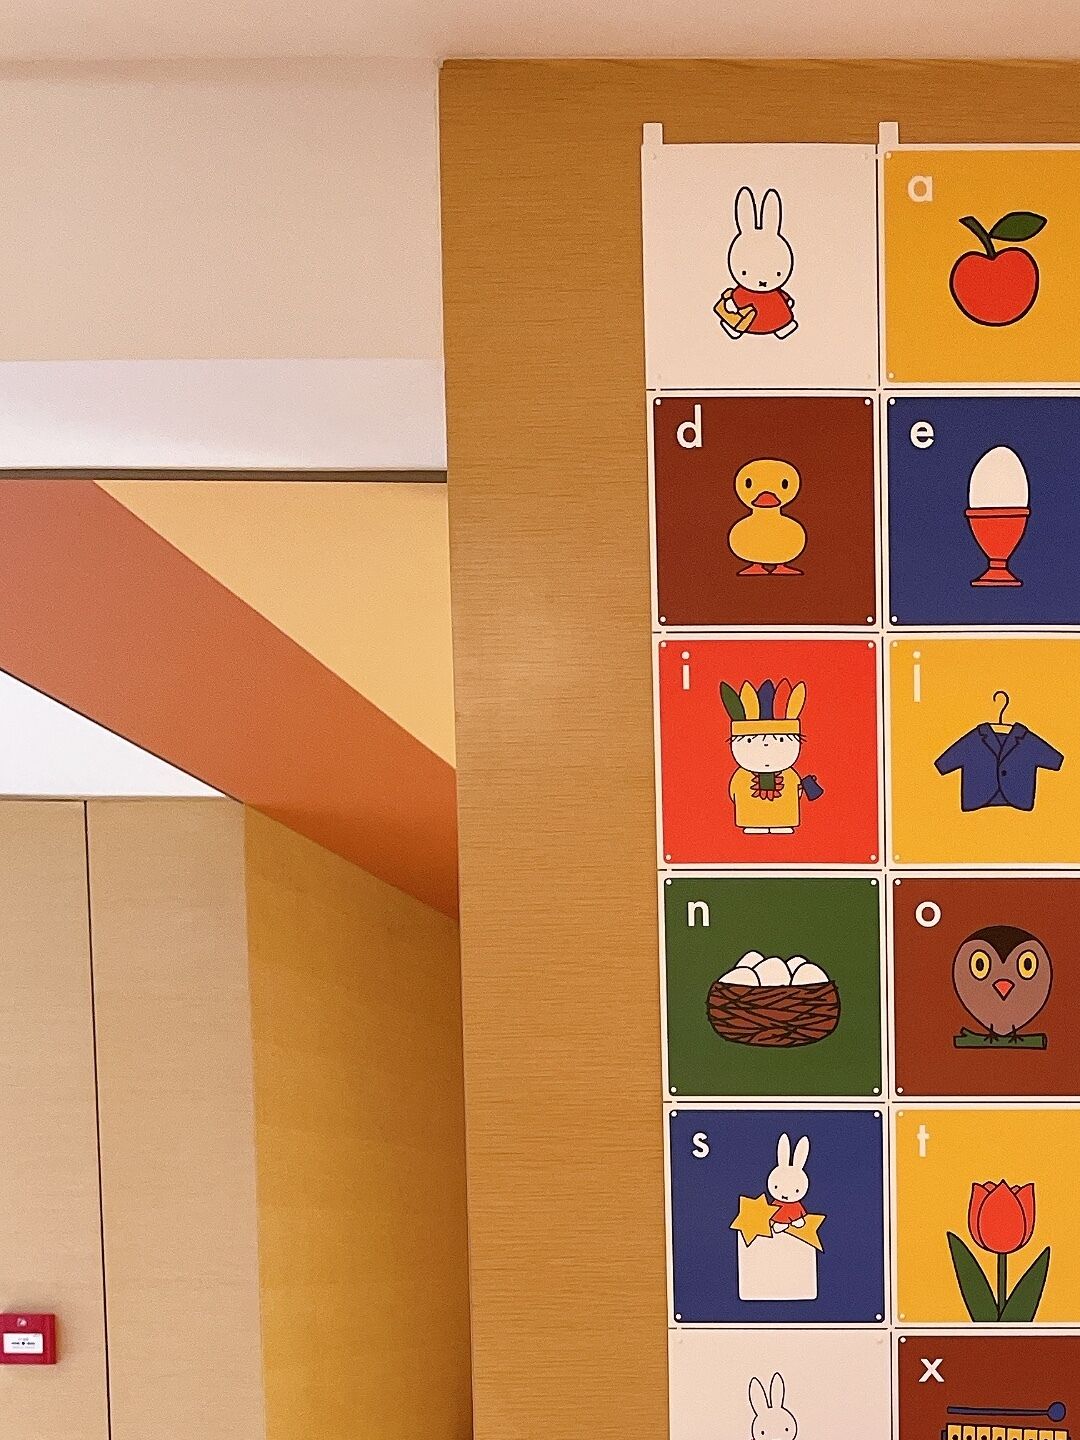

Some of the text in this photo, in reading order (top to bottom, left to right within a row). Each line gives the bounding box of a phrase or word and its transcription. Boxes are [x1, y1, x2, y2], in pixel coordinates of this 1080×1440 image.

[907, 175, 933, 203] a
[676, 404, 703, 449] d
[910, 421, 934, 449] e
[681, 651, 690, 690] i
[687, 901, 710, 927] n
[915, 901, 942, 928] o
[692, 1132, 710, 1158] s
[916, 1124, 930, 1158] t
[918, 1358, 945, 1383] x
